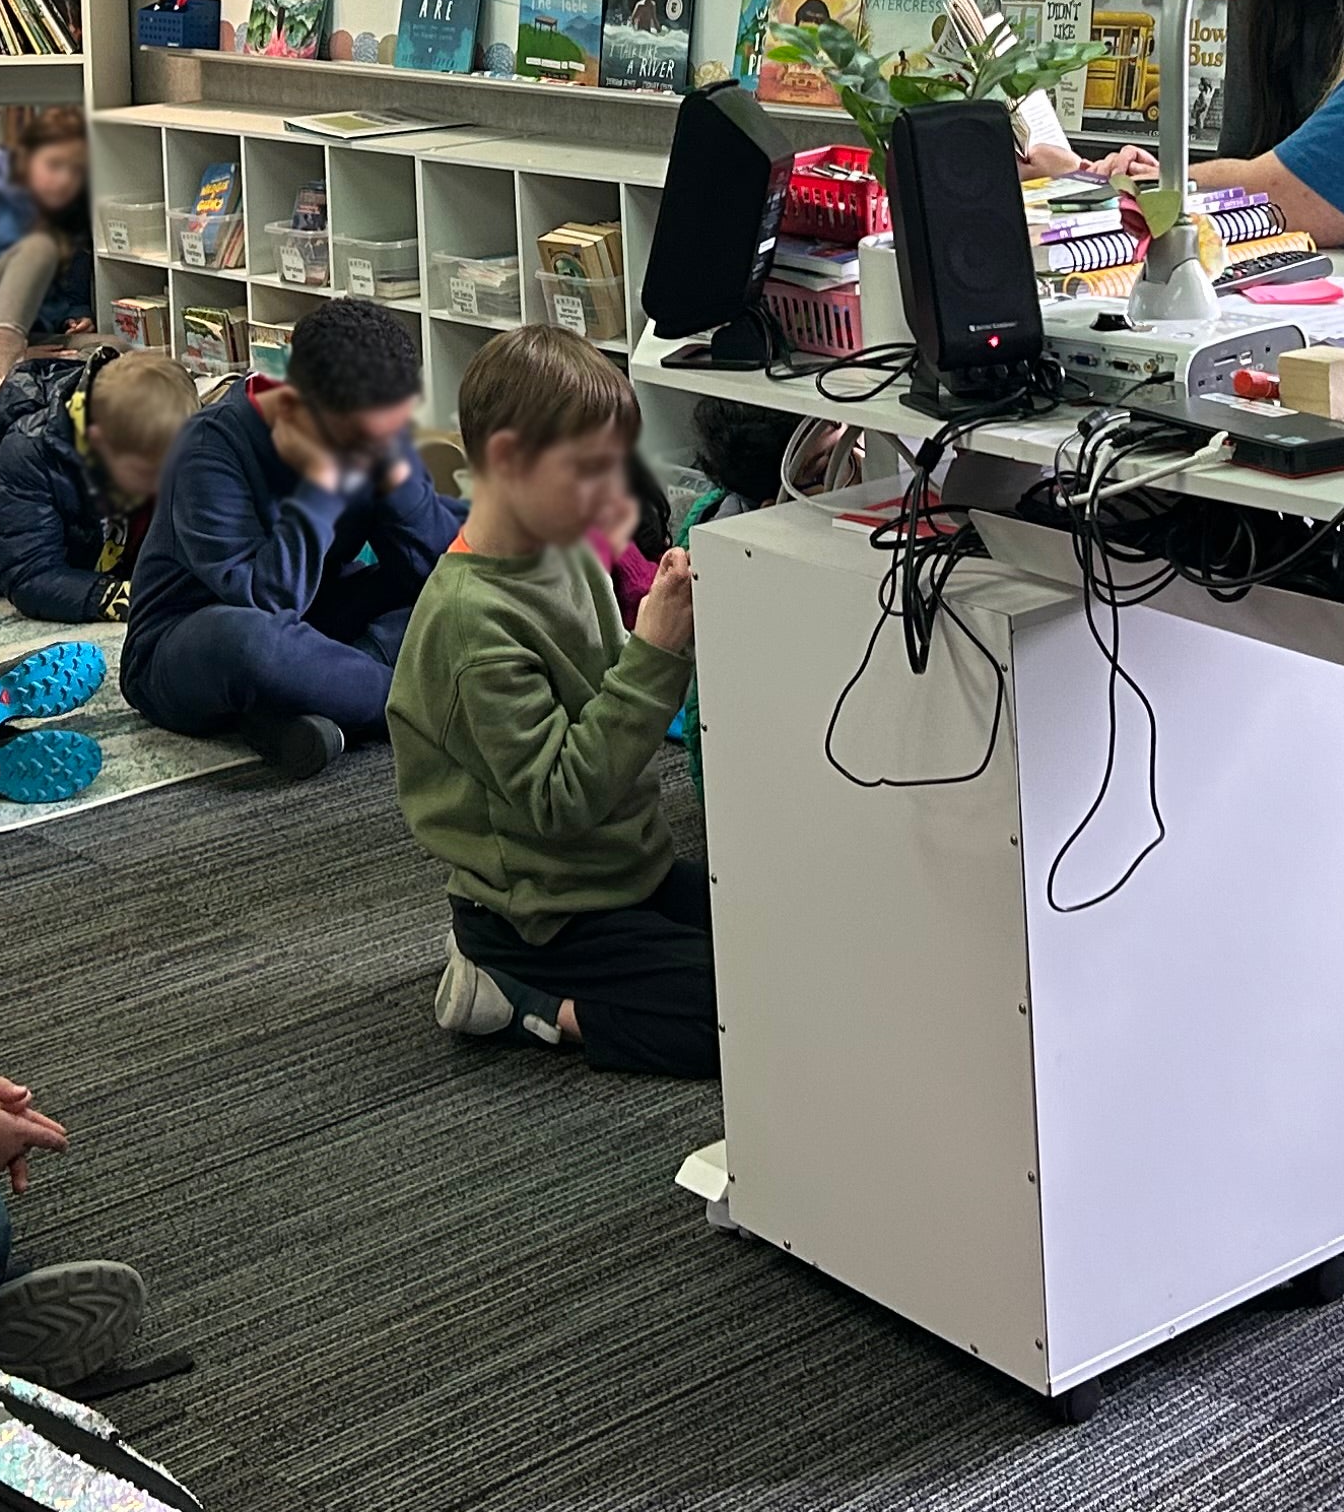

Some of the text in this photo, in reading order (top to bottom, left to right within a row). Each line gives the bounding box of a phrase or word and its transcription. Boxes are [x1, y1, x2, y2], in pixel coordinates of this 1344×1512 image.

[1047, 0, 1082, 21] DIDN'T
[1054, 23, 1076, 40] LIKE
[1189, 44, 1224, 68] Bus
[626, 58, 675, 80] A RIVER
